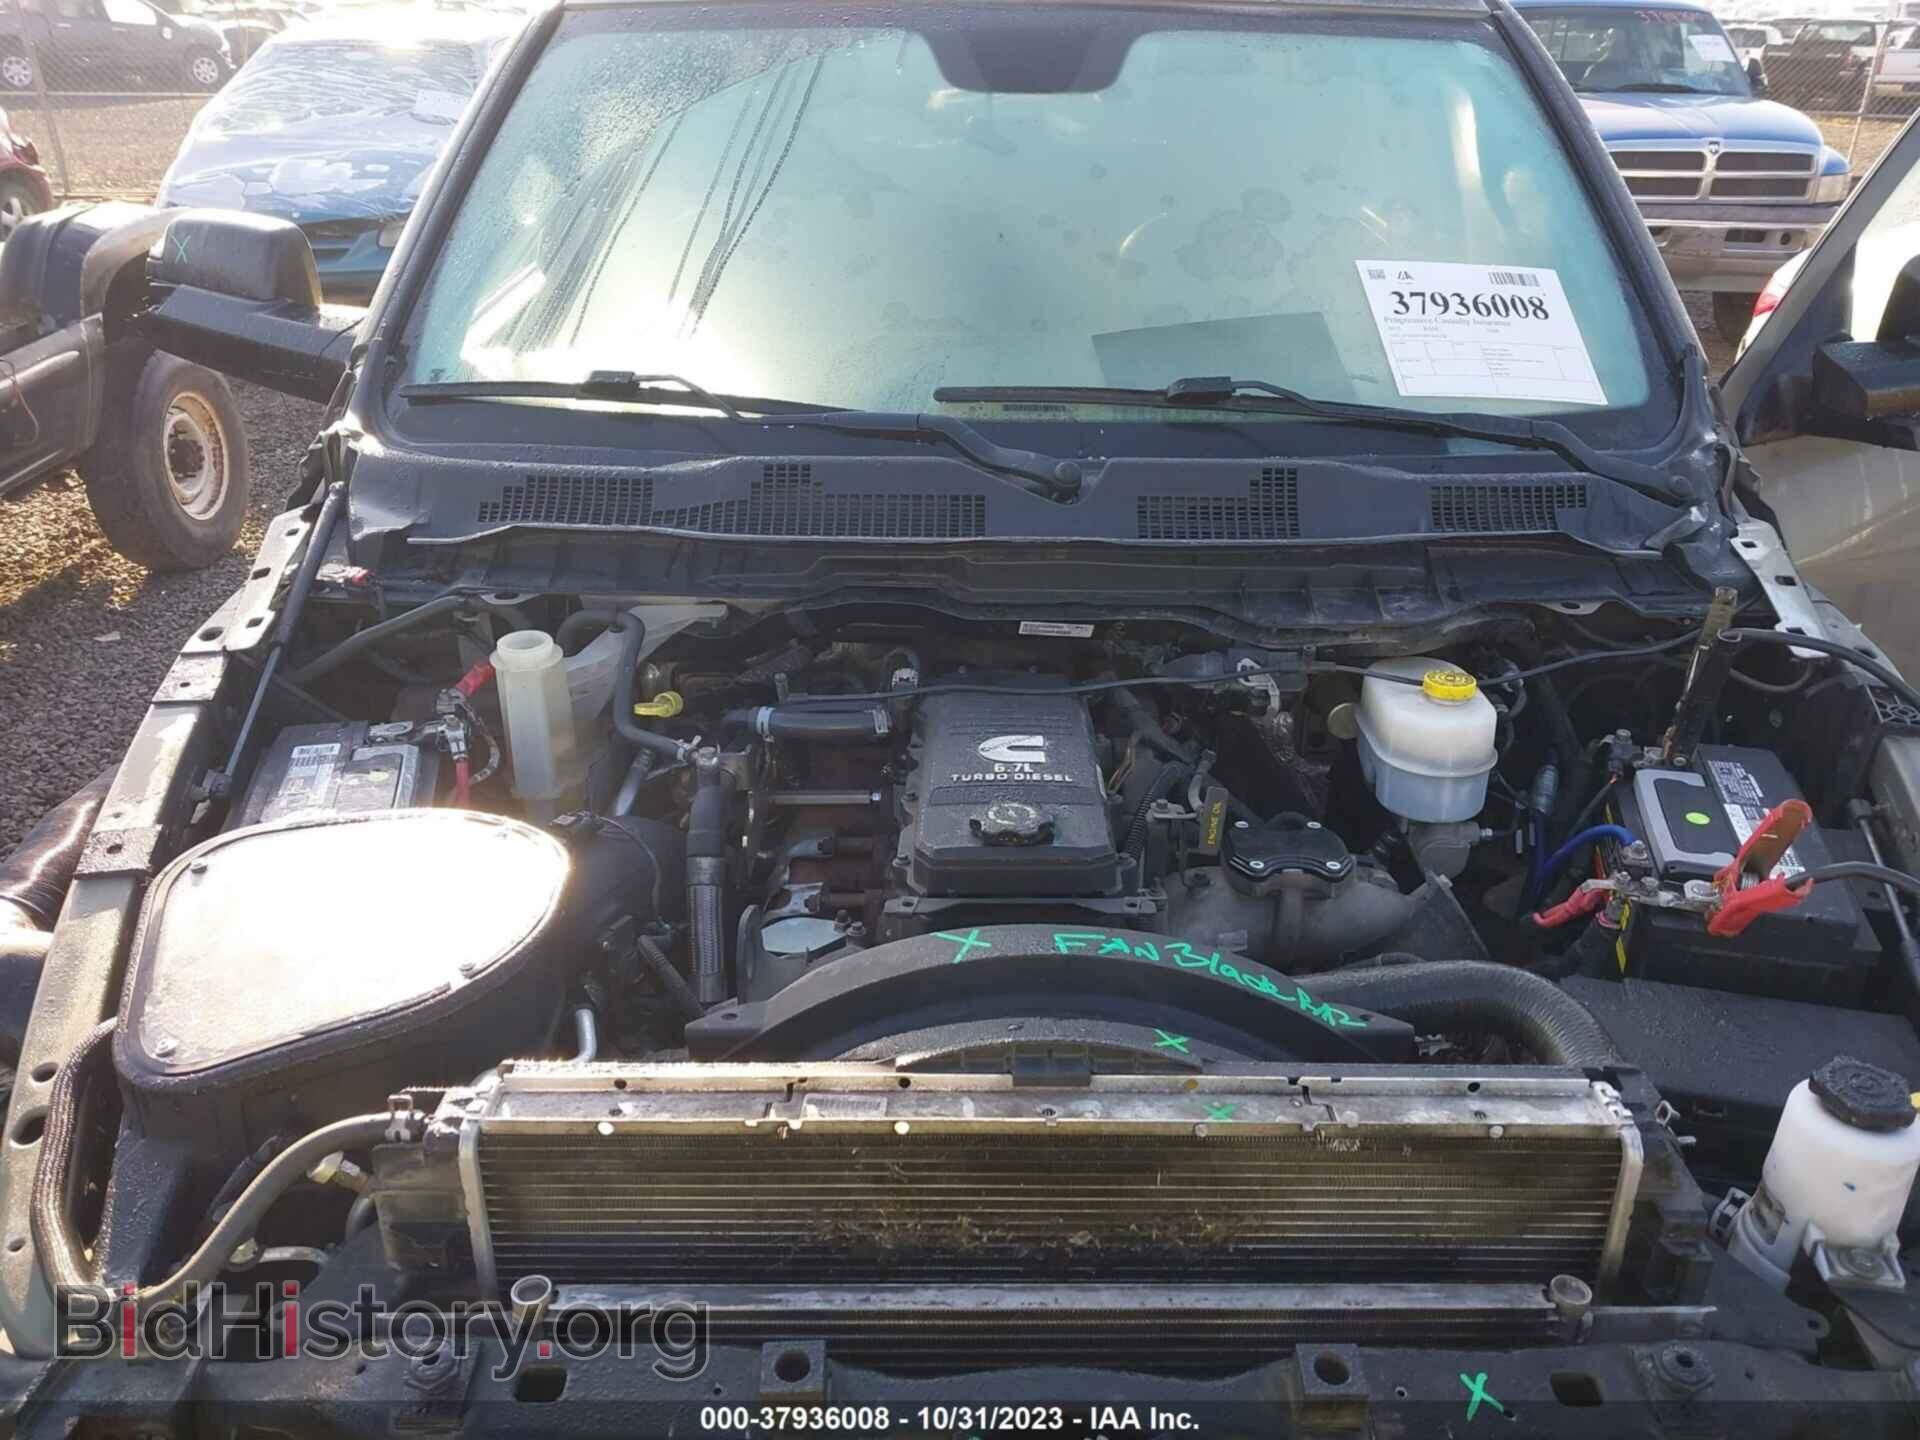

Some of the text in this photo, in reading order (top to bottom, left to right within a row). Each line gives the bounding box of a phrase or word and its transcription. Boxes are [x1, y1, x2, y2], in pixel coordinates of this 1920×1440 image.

[1391, 290, 1550, 321] 37936008
[952, 773, 1073, 783] TURBO DIESEL
[994, 763, 1034, 773] 6.7L
[1054, 932, 1161, 962] FAN
